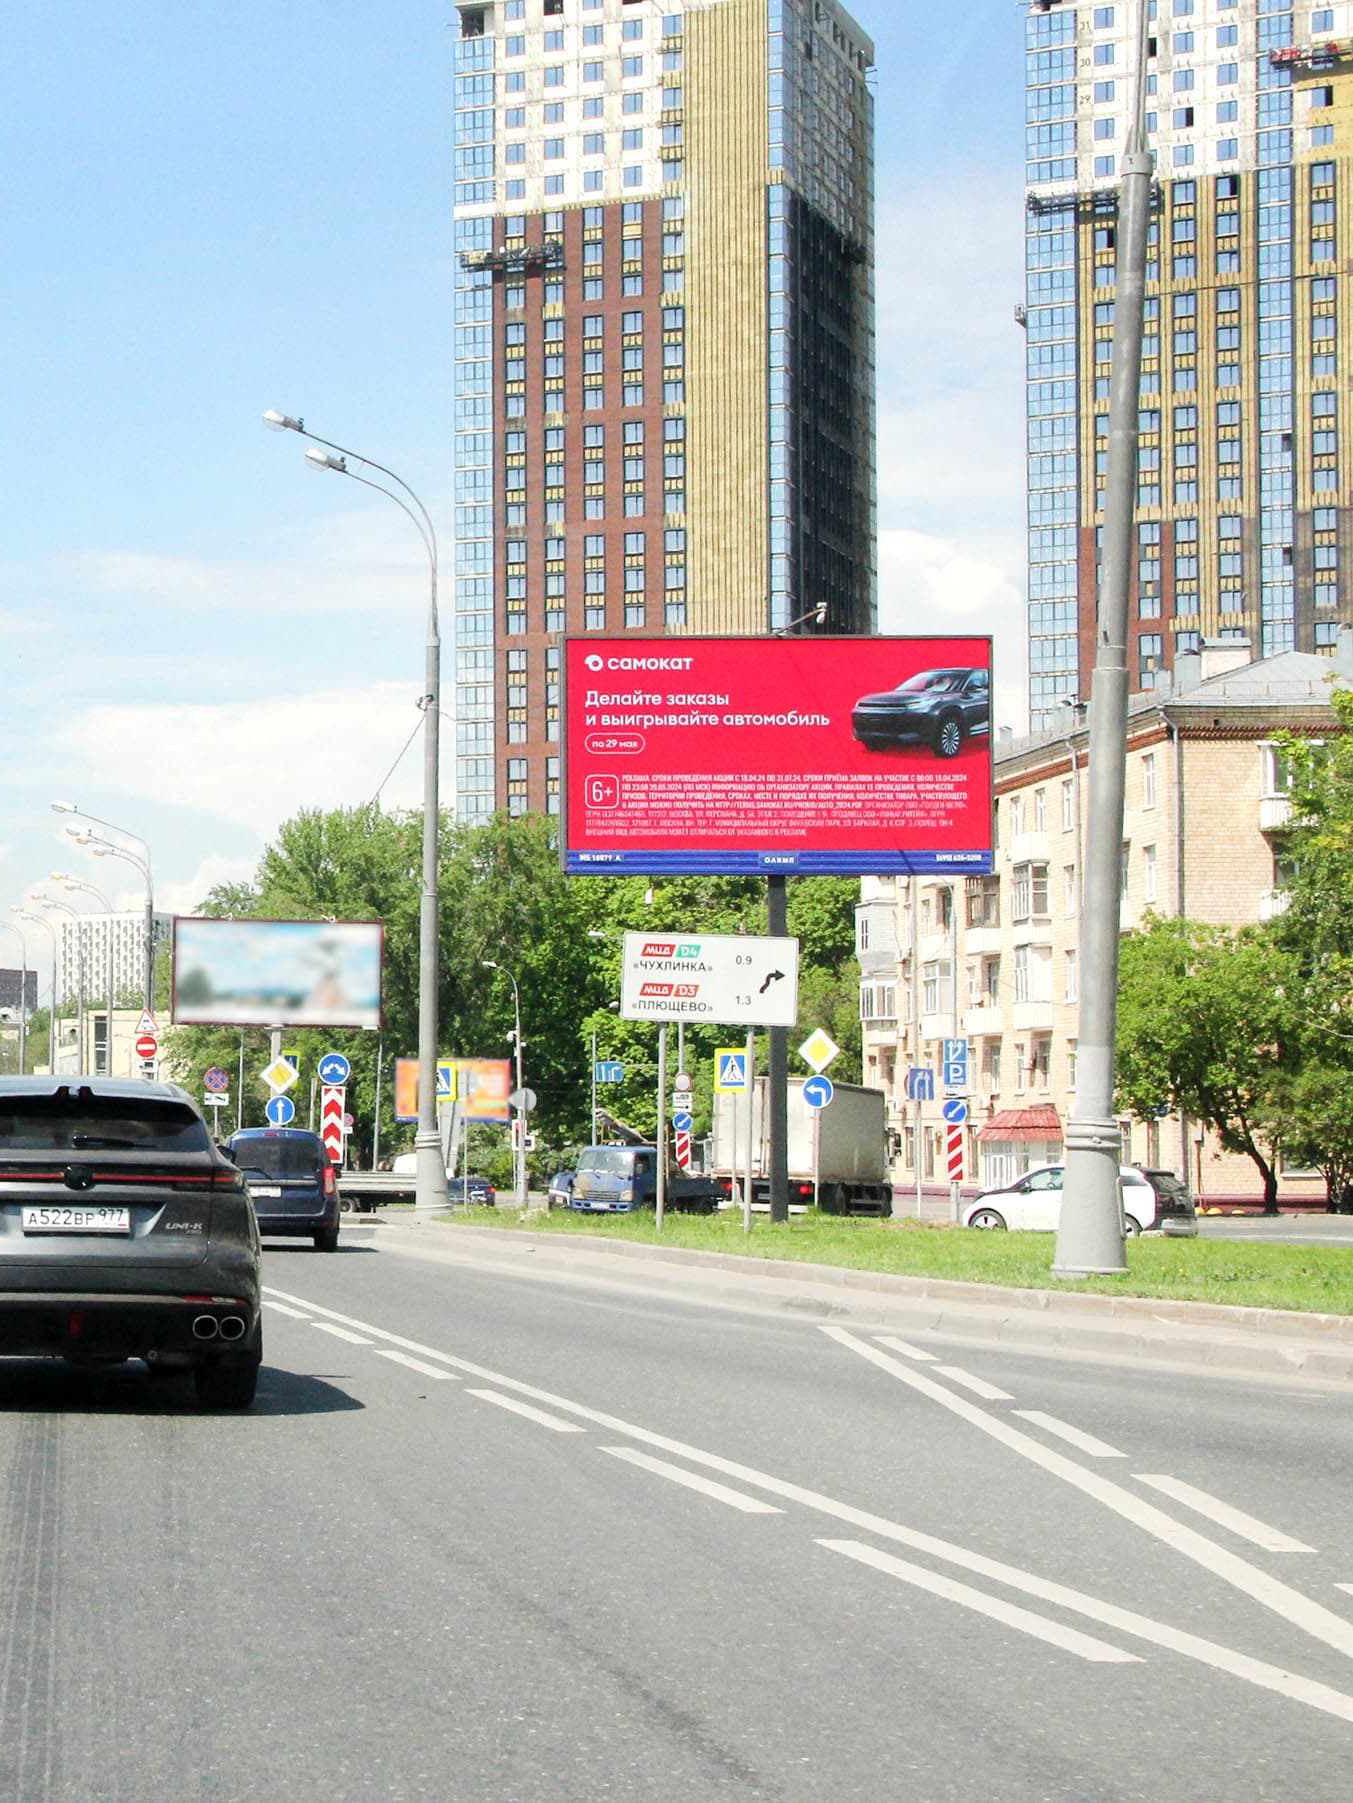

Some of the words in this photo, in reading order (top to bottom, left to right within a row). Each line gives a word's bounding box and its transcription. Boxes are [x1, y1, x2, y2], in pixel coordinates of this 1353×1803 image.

[608, 657, 694, 671] самокат
[585, 690, 662, 708] Делайте
[666, 693, 730, 706] заказы
[585, 714, 597, 726] и
[601, 710, 719, 729] выигрывайте
[723, 711, 831, 726] автомобиль
[592, 740, 604, 748] по
[606, 739, 617, 748] 29
[619, 740, 638, 748] мая
[592, 781, 613, 802] 6+
[633, 961, 713, 972] «ЧУХЛИНКА»
[735, 955, 752, 966] 0.9
[632, 1000, 713, 1012] «ПЛЮЩЕВО»
[736, 995, 752, 1005] 1.3
[28, 1209, 94, 1225] А522ВР
[98, 1208, 123, 1221] 977
